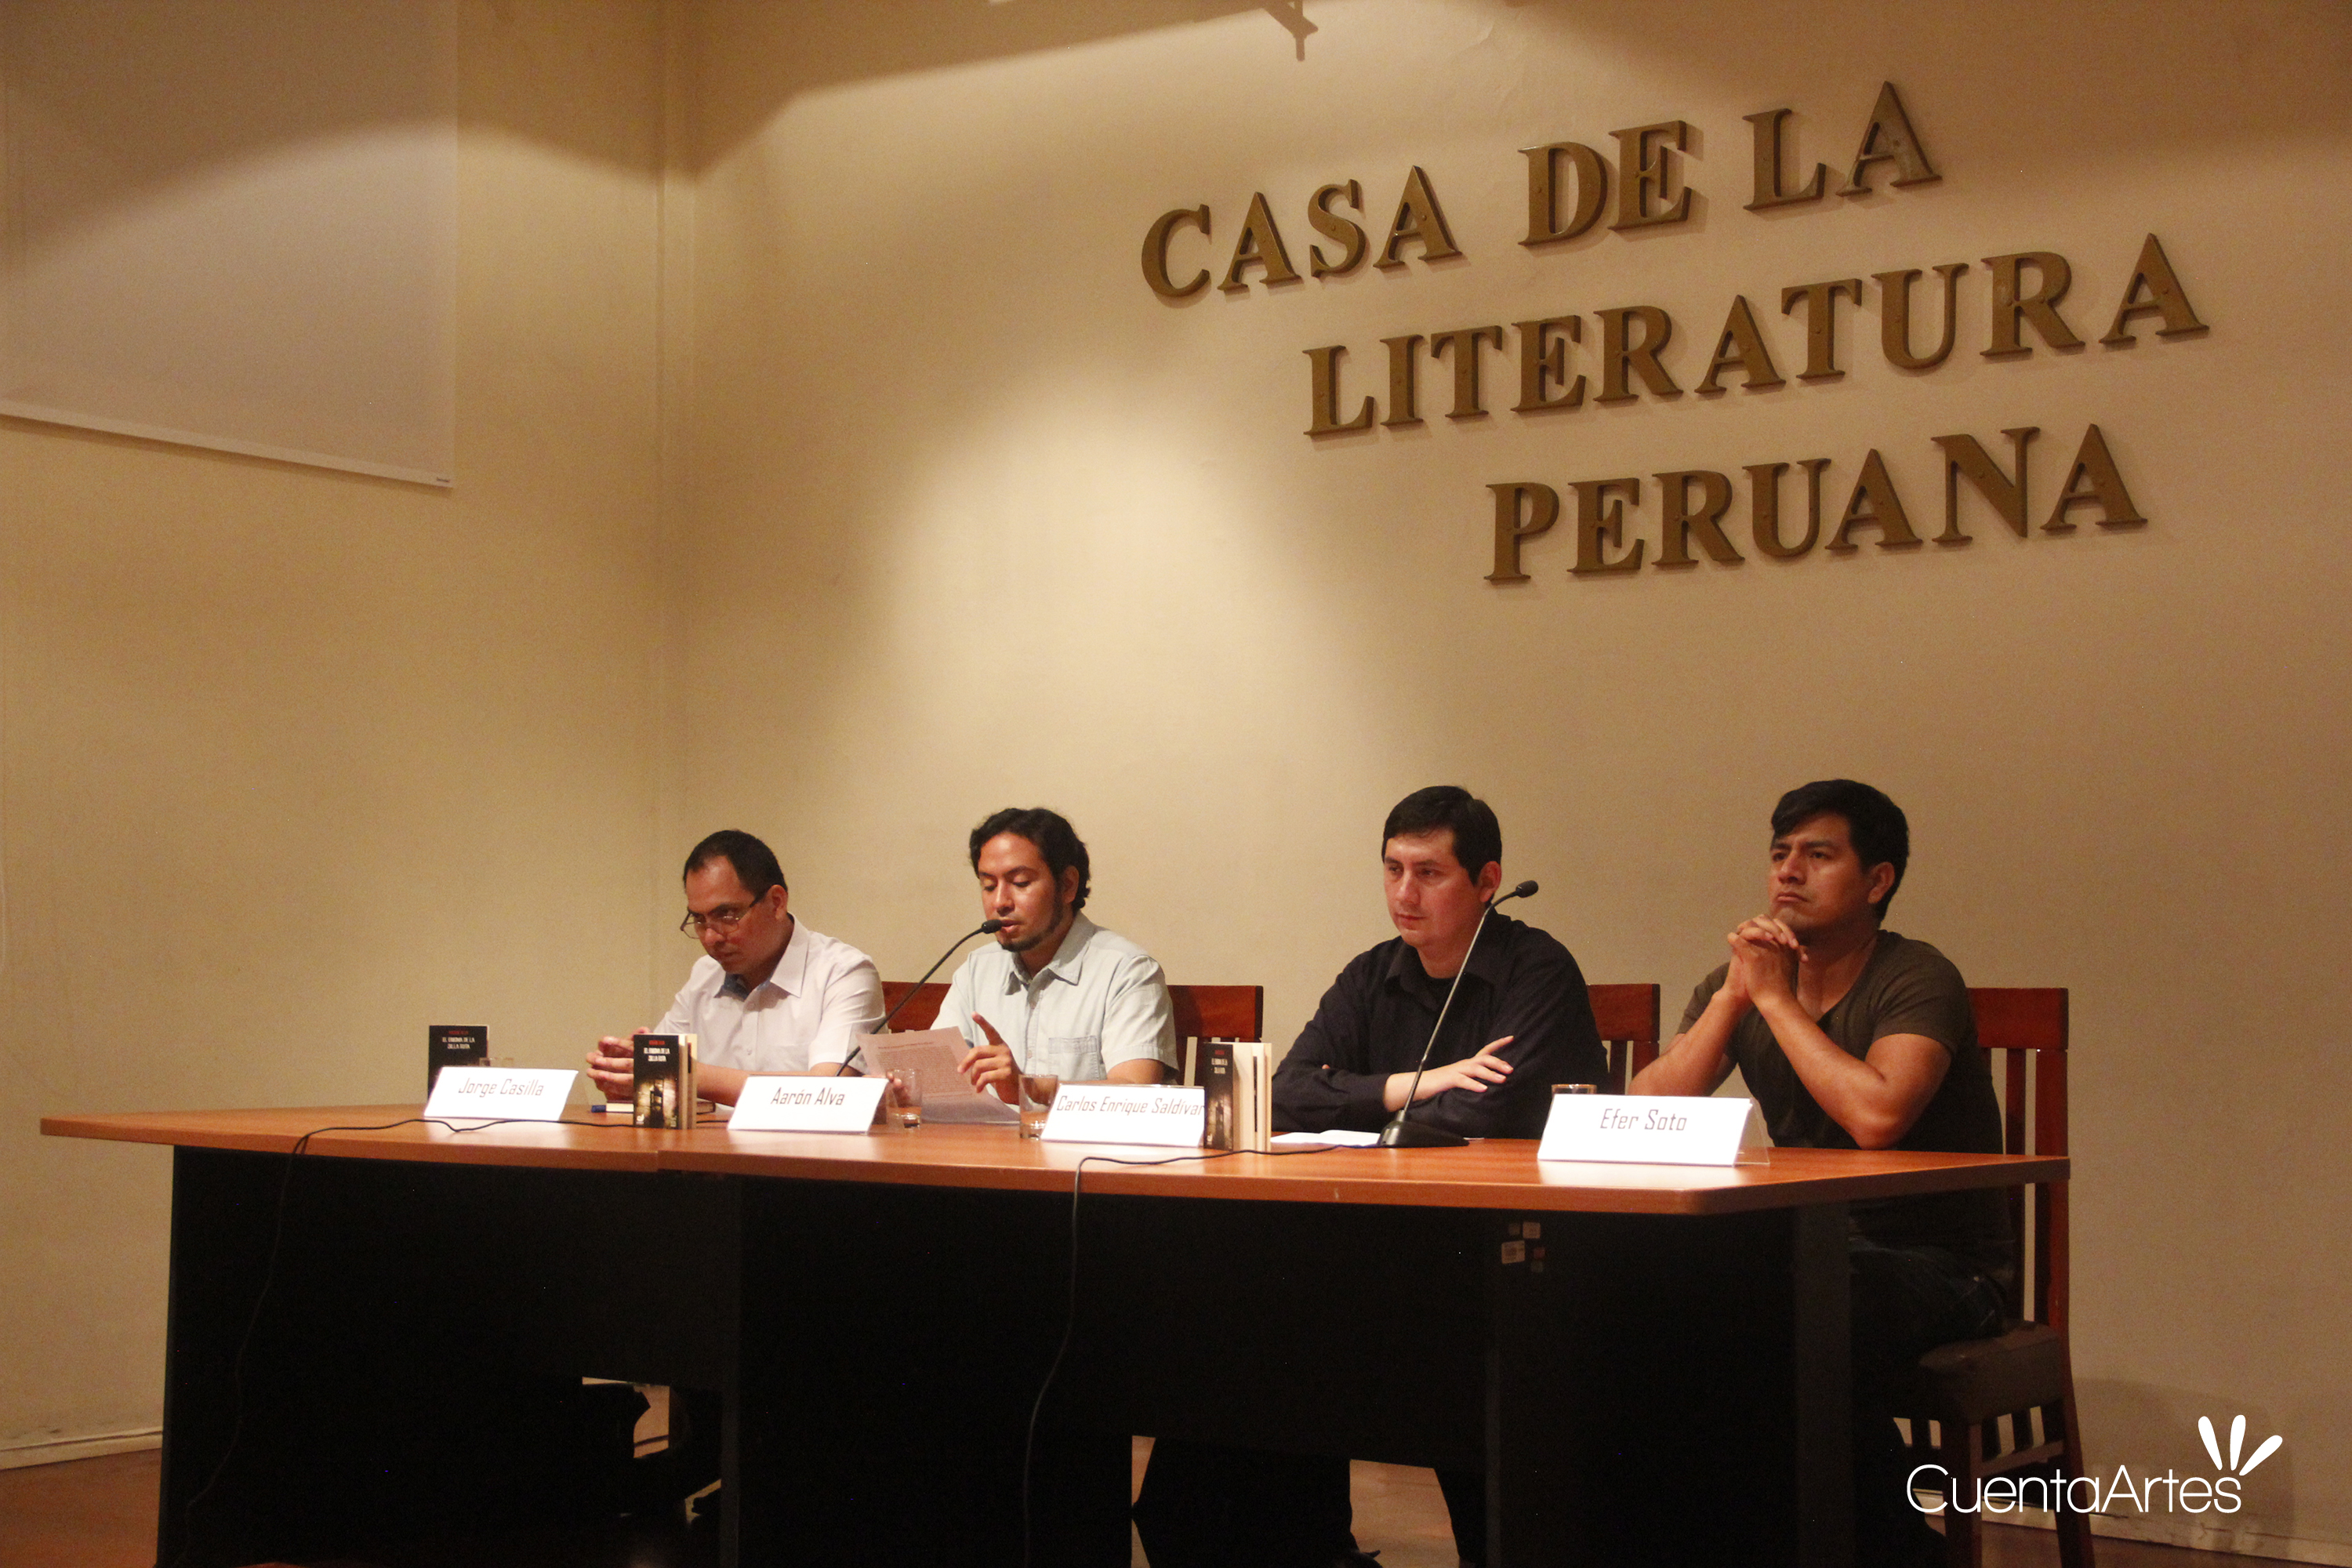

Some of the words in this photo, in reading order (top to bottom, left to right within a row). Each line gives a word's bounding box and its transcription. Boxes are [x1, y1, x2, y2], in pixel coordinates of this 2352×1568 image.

[1141, 165, 1463, 298] CASA
[1517, 119, 1692, 247] DE
[1741, 79, 1943, 212] LA
[1302, 233, 2209, 437] LITERATURA
[1483, 423, 2147, 583] PERUANA
[458, 1077, 497, 1098] Jorge
[500, 1079, 544, 1096] Casilla
[770, 1087, 812, 1105] Aarón
[814, 1087, 845, 1105] Alva
[1056, 1095, 1097, 1112] Carlos
[1100, 1096, 1148, 1116] Enrique
[1151, 1098, 1204, 1116] Saldívar
[1600, 1108, 1639, 1129] Efer
[1644, 1109, 1687, 1131] Soto
